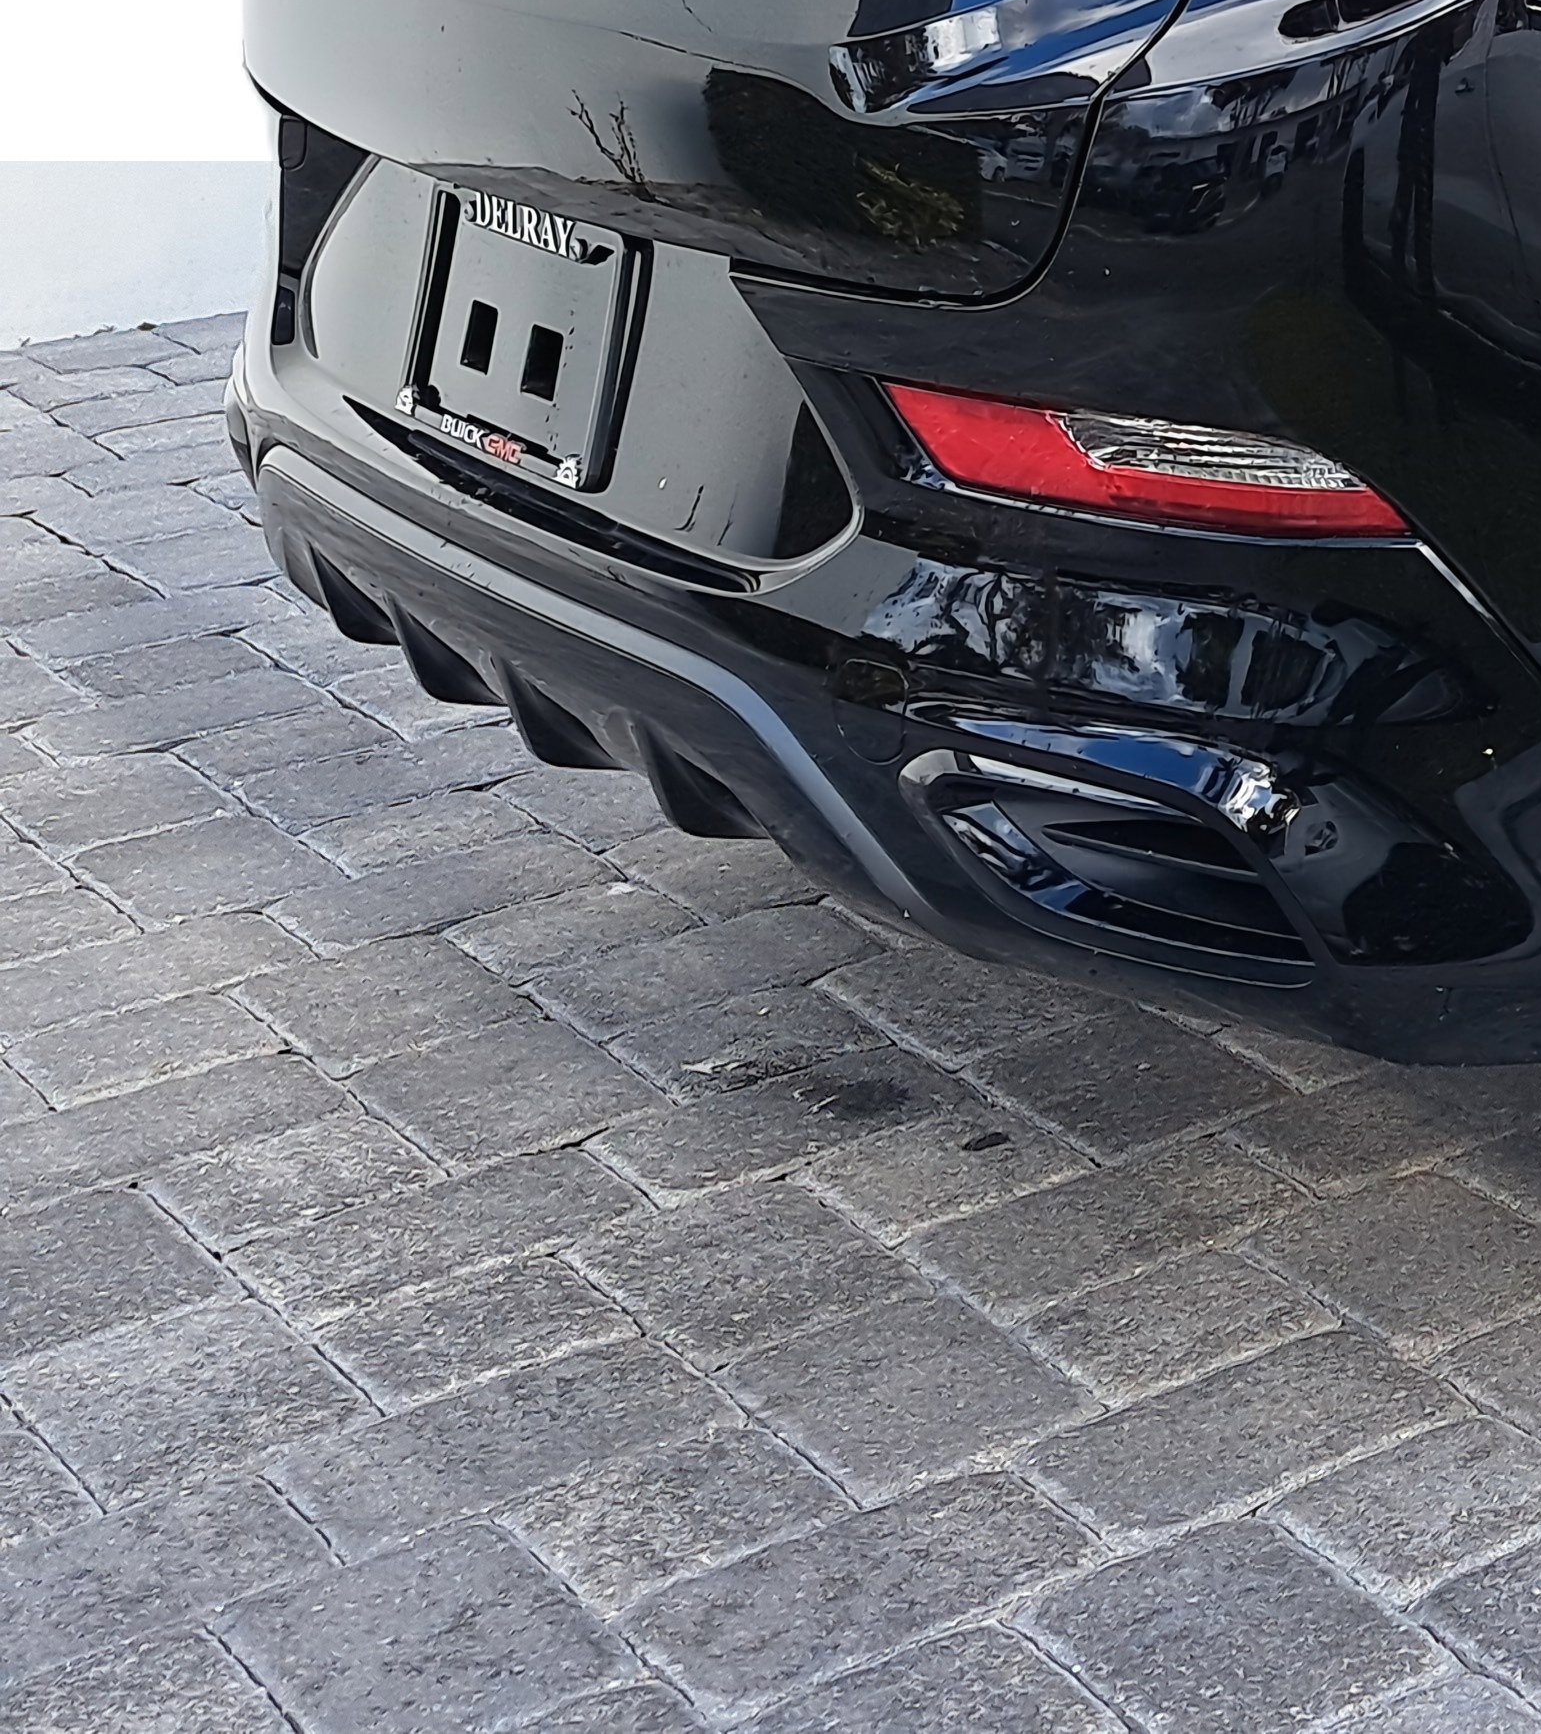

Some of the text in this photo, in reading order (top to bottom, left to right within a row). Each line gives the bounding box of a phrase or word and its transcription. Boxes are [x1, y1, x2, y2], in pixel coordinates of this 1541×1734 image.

[474, 191, 575, 258] DELRAY
[440, 413, 526, 464] BUICK GMC
